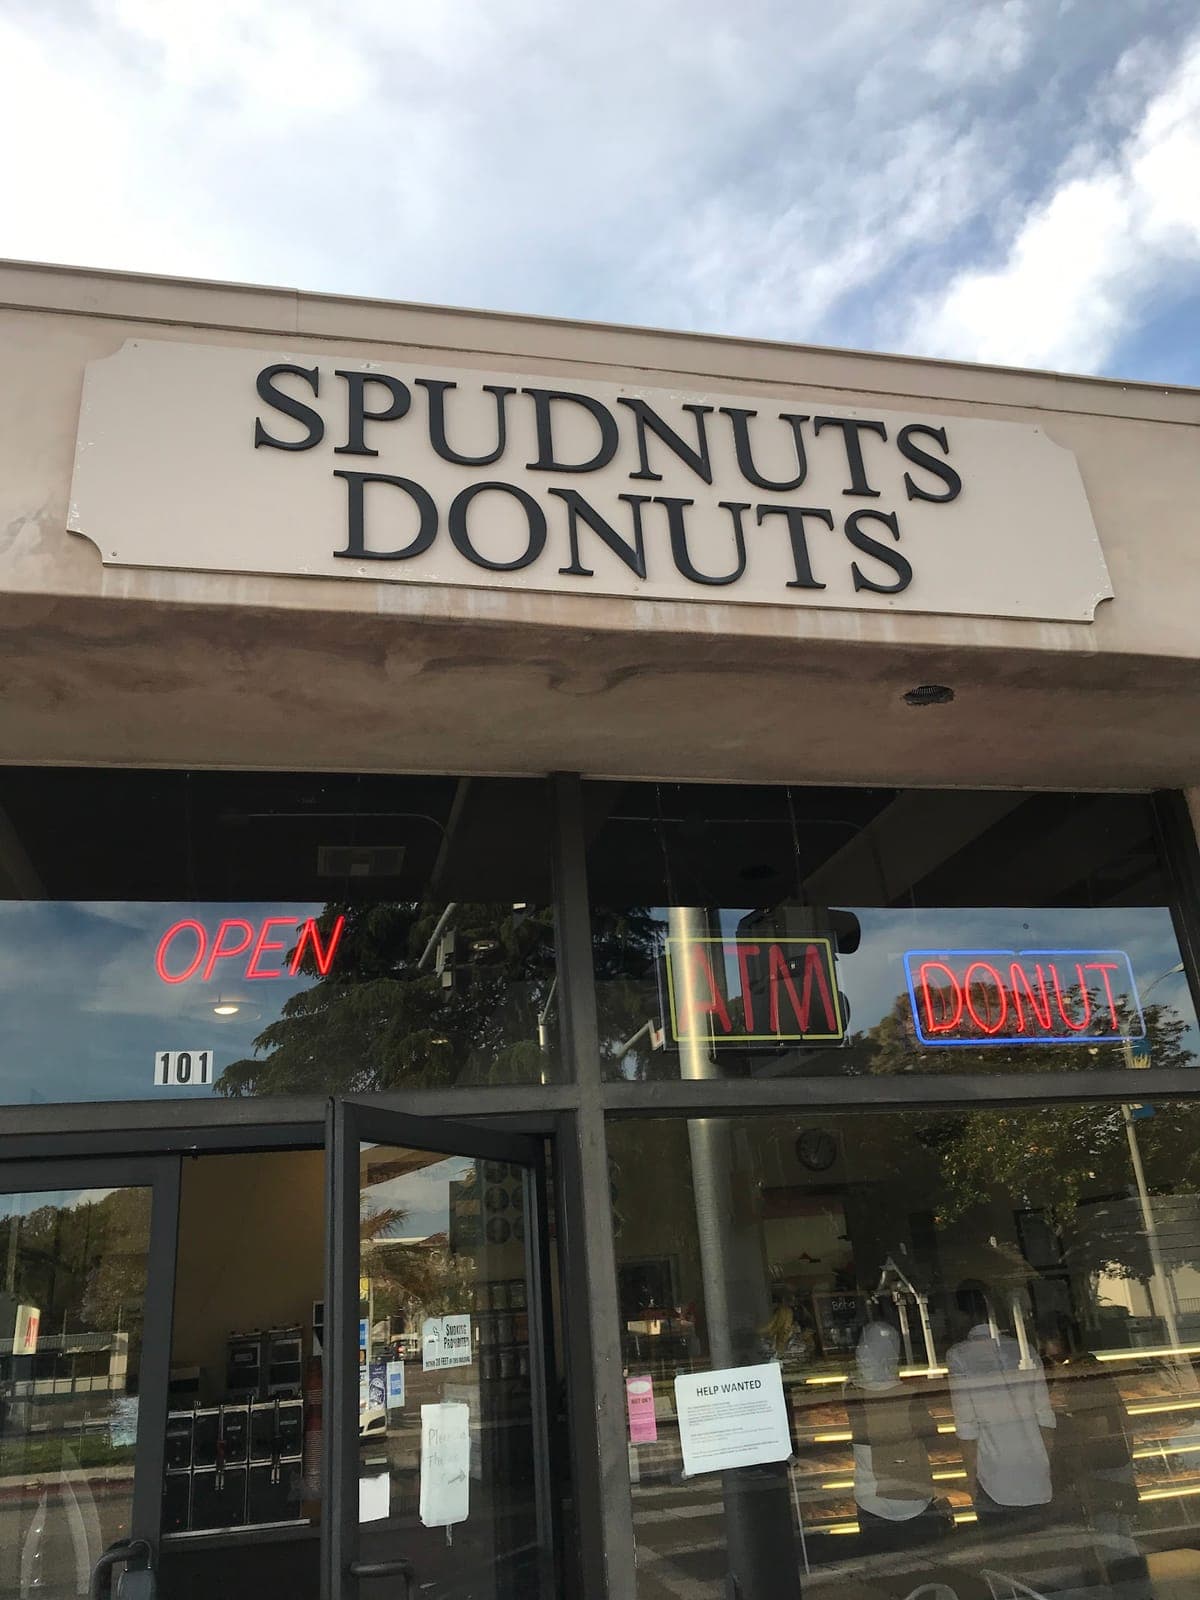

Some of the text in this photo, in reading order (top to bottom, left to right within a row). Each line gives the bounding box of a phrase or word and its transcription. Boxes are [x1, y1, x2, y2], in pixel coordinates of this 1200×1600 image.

[254, 363, 963, 503] SPUDNUTS
[333, 469, 914, 594] DONUTS
[155, 914, 346, 985] OPEN
[678, 943, 838, 1033] ATM
[919, 961, 1119, 1034] DONUT
[160, 1052, 209, 1084] 101
[696, 1379, 762, 1397] HELP WANTED
